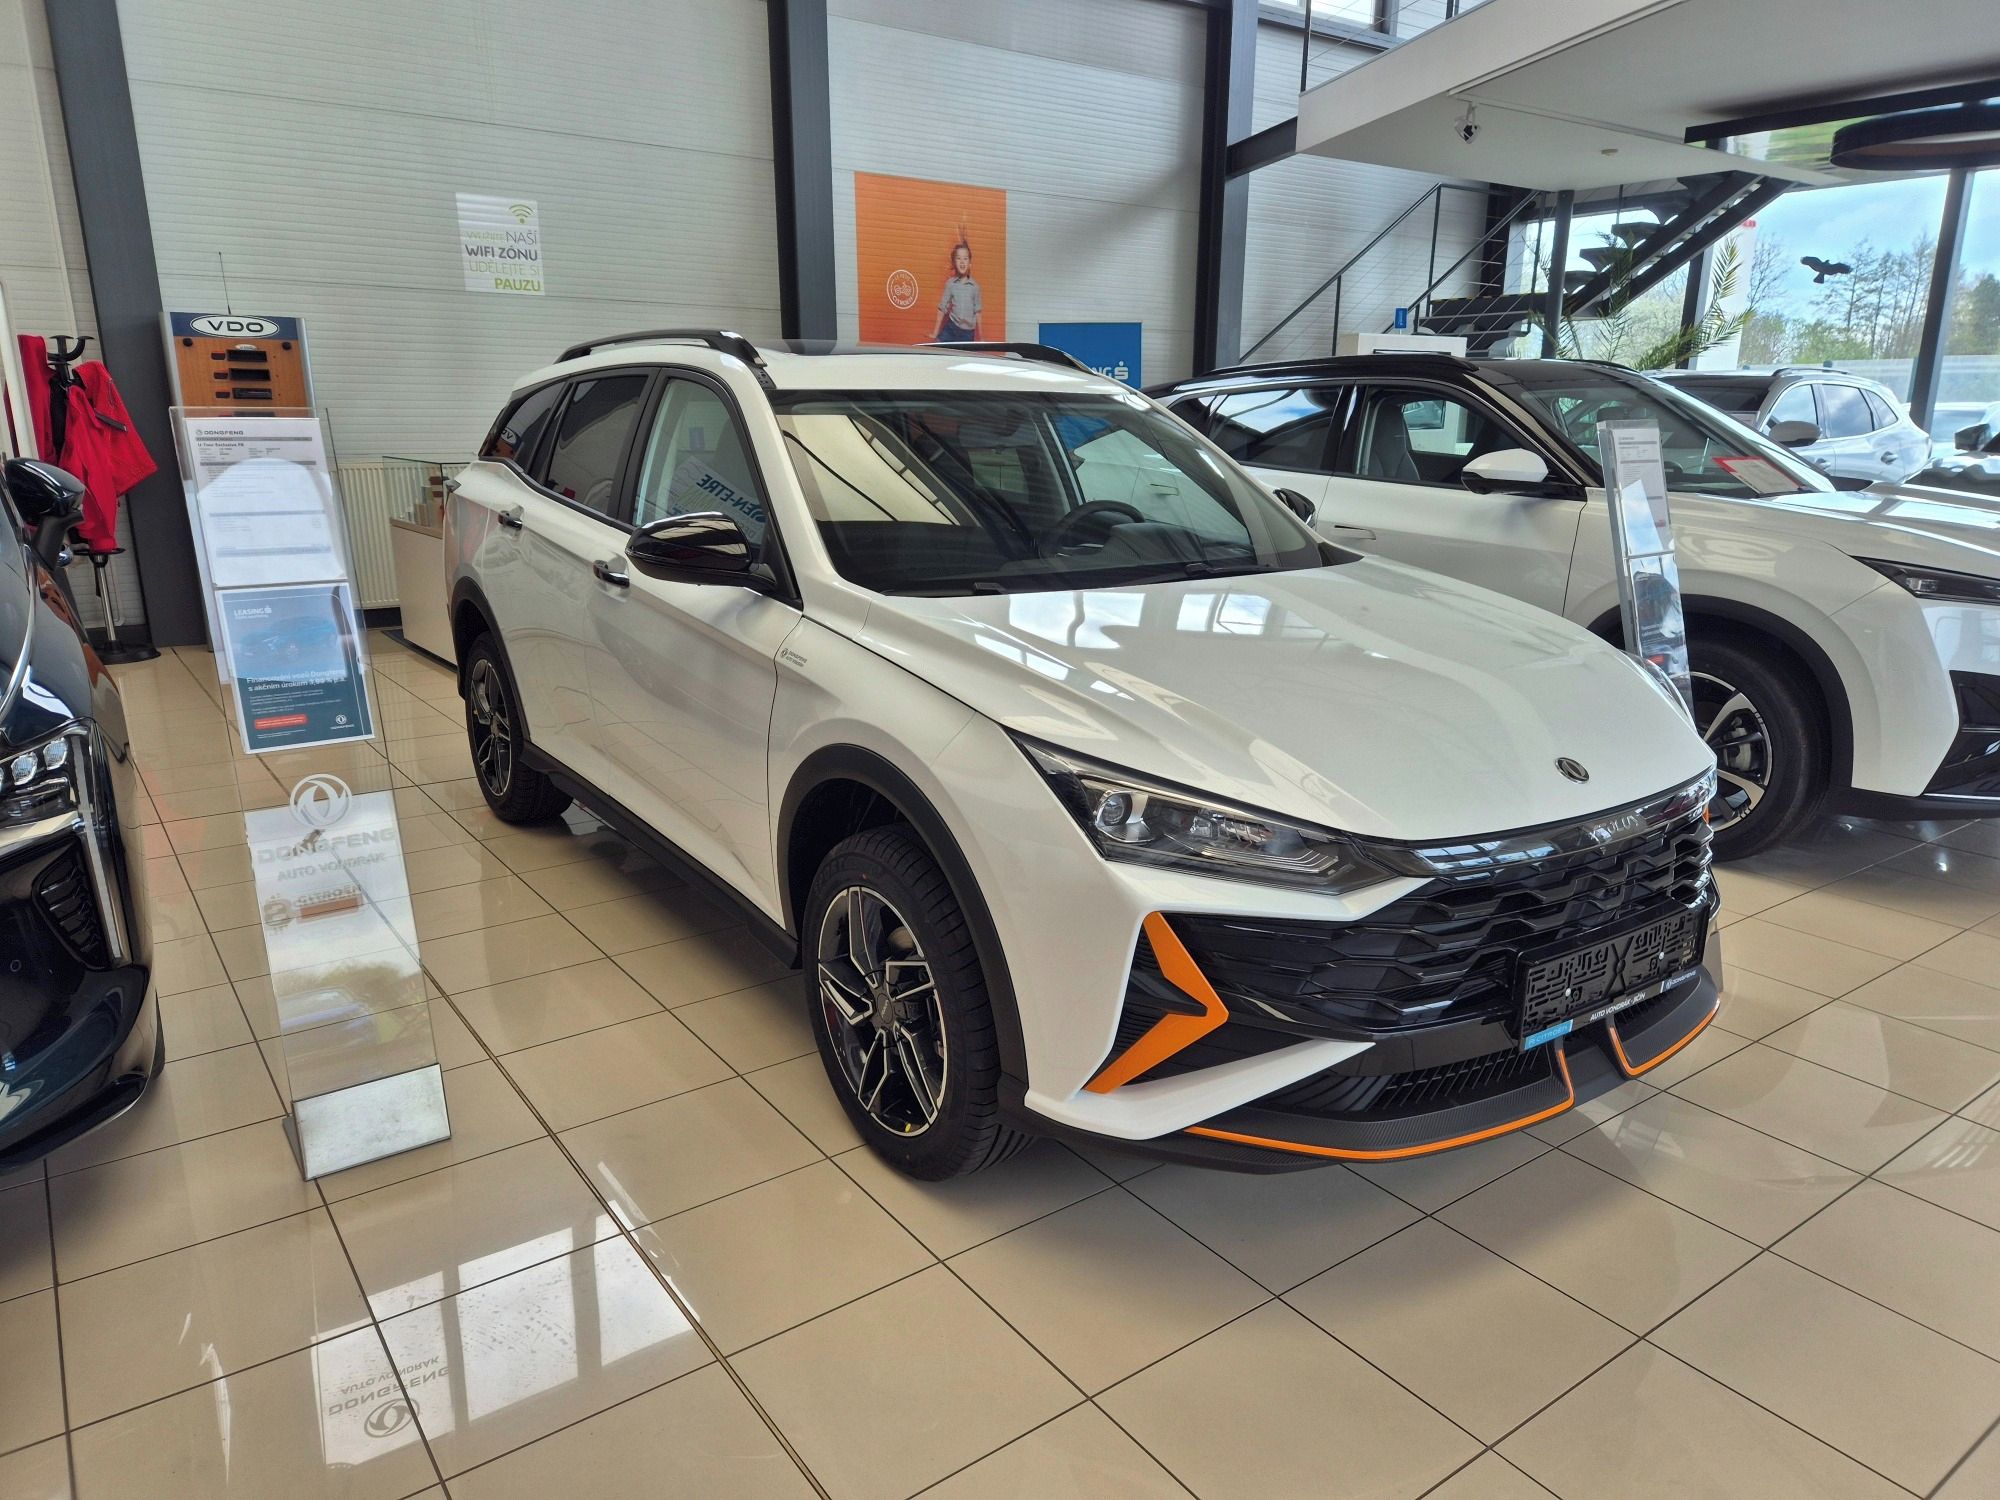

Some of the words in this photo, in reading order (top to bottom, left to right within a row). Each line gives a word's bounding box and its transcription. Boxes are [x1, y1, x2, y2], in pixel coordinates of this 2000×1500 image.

[465, 244, 495, 258] WIFI
[498, 245, 538, 261] ZÓNU
[494, 277, 541, 292] PAUZU
[208, 320, 264, 333] VDO
[1590, 1009, 1606, 1021] AUTO
